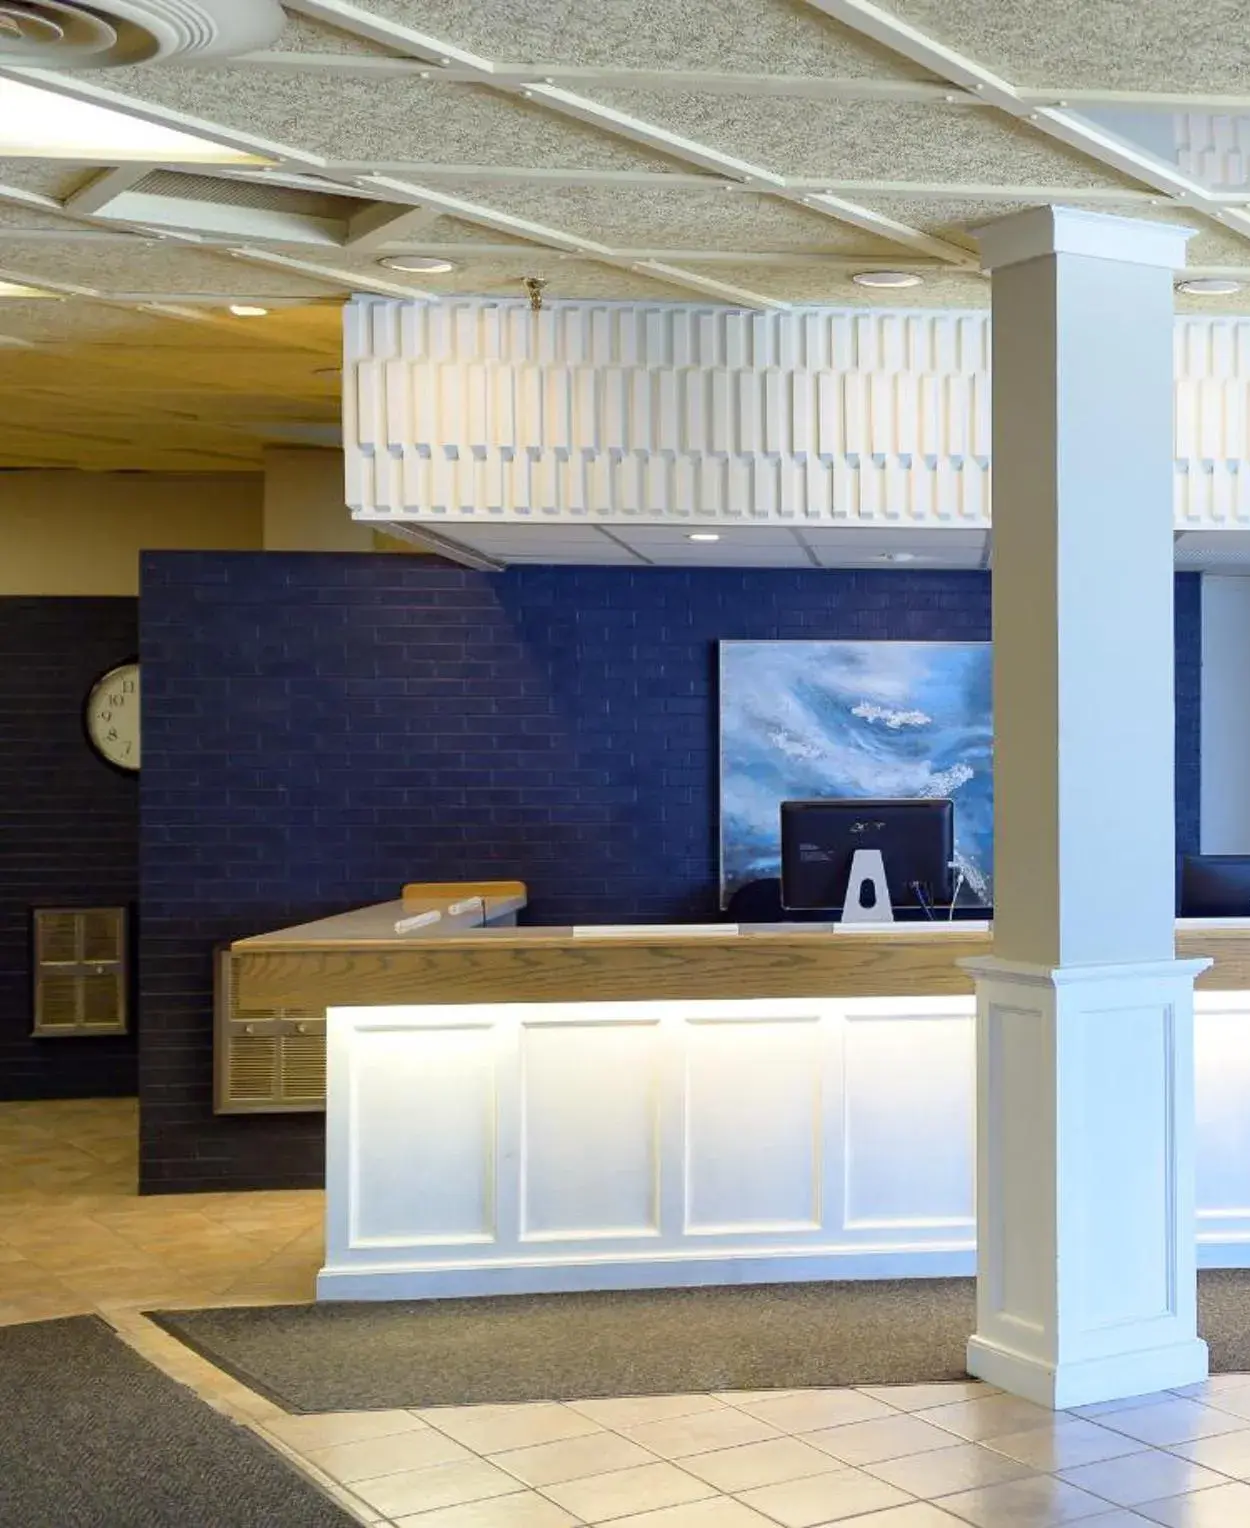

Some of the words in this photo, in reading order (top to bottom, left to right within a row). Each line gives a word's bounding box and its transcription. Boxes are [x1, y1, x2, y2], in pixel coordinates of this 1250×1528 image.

[109, 694, 124, 707] 10
[101, 711, 112, 722] 9
[107, 727, 118, 742] 8
[122, 740, 132, 755] 7
